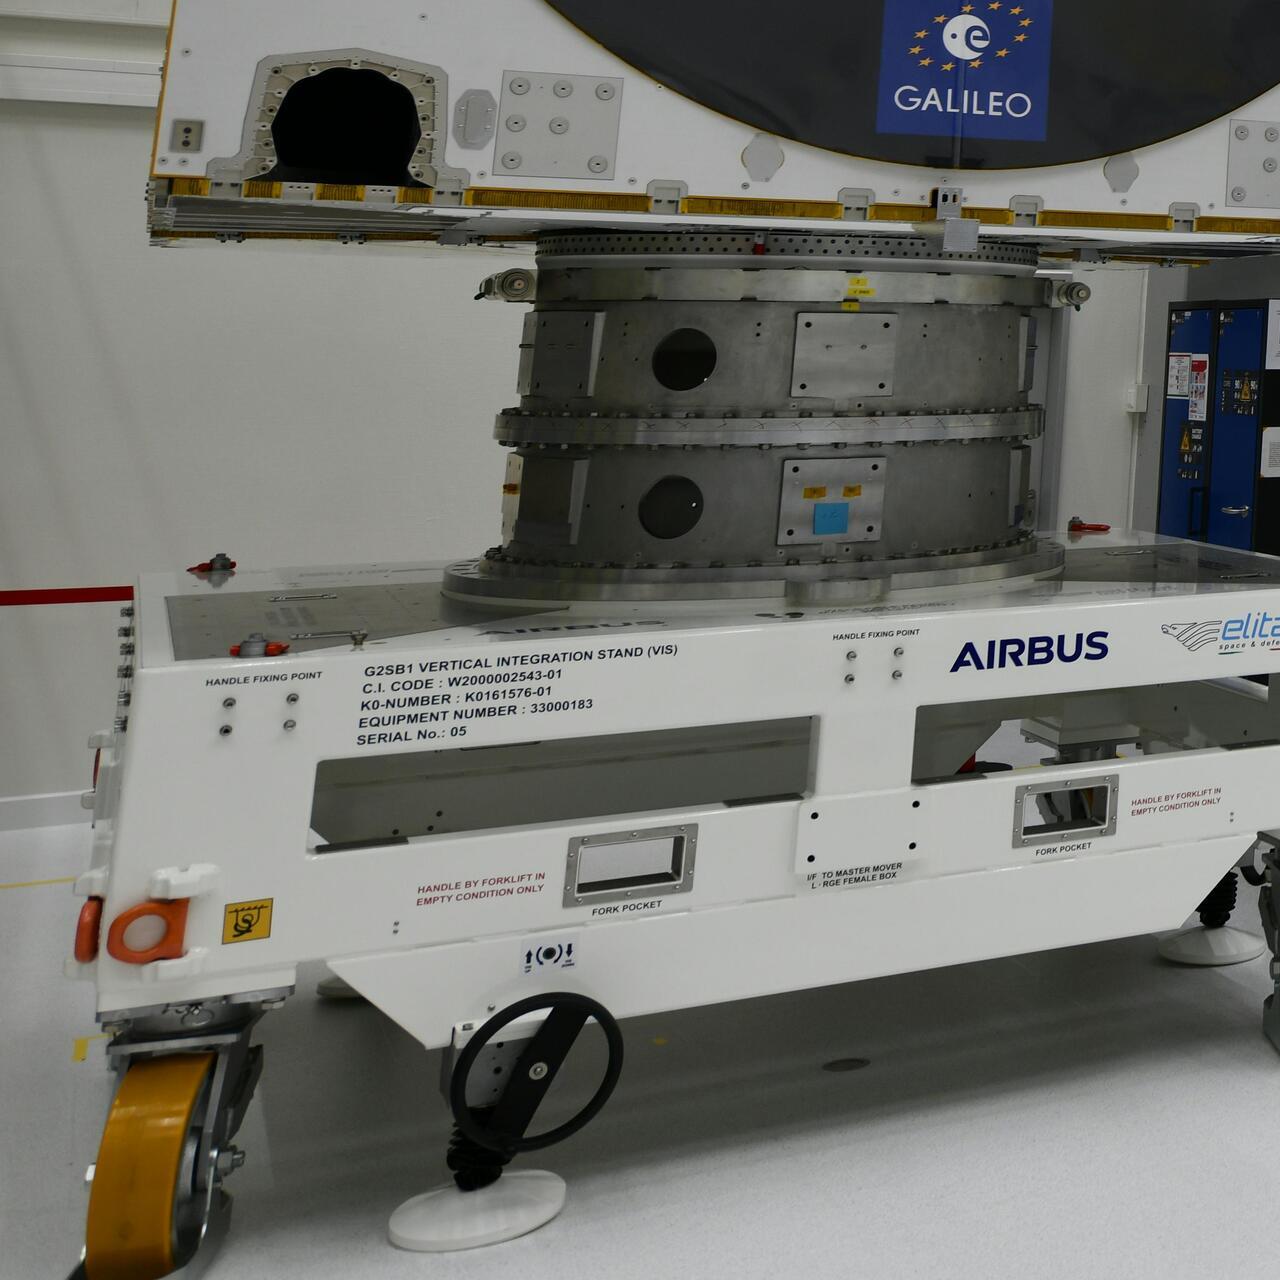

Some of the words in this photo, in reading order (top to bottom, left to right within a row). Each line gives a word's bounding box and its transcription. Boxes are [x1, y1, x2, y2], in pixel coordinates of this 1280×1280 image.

[894, 85, 1032, 118] GALILEO
[832, 633, 866, 641] HANDLE
[868, 631, 894, 639] FIXING
[896, 628, 920, 637] POINT
[949, 631, 1109, 673] AIRBUS
[1219, 642, 1246, 651] space
[364, 664, 413, 677] G2SB1
[419, 658, 492, 672] VERTICAL
[497, 650, 593, 667] INTEGRATION
[598, 646, 643, 660] STAND
[648, 644, 678, 658] (VIS)
[206, 676, 250, 687] HANDLE
[253, 673, 288, 684] FIXING
[290, 671, 323, 680] POINT
[362, 683, 385, 694] C.I.
[391, 679, 434, 692] CODE
[448, 669, 562, 687] W2000002543-01
[465, 686, 552, 703] K0161576-01
[359, 710, 449, 728] EQUIPMENT
[453, 704, 517, 720] NUMBER
[530, 699, 593, 714] 33000183
[356, 732, 412, 746] SERIAL
[450, 726, 467, 737] 05
[1131, 796, 1163, 807] HANDLE
[1164, 794, 1175, 802] BY
[1176, 789, 1212, 800] FORKLIFT
[1214, 787, 1222, 795] IN
[1131, 807, 1157, 816] EMPTY
[1159, 801, 1199, 813] CONDITION
[1201, 797, 1222, 807] ONLY
[1036, 847, 1058, 856] FORK
[1060, 842, 1092, 853] POCKET
[822, 871, 833, 879] TO
[835, 866, 870, 877] MASTER
[872, 862, 903, 872] MOVER
[843, 874, 877, 885] FEMALE
[879, 871, 897, 880] BOX
[417, 881, 461, 894] HANDLE
[464, 880, 479, 888] BY
[481, 874, 533, 887] FORKLIFT
[535, 872, 546, 880] IN
[416, 895, 453, 906] EMPTY
[455, 888, 514, 902] CONDITION
[517, 884, 545, 894] ONLY
[592, 907, 620, 917] FORK
[622, 900, 663, 913] POCKET
